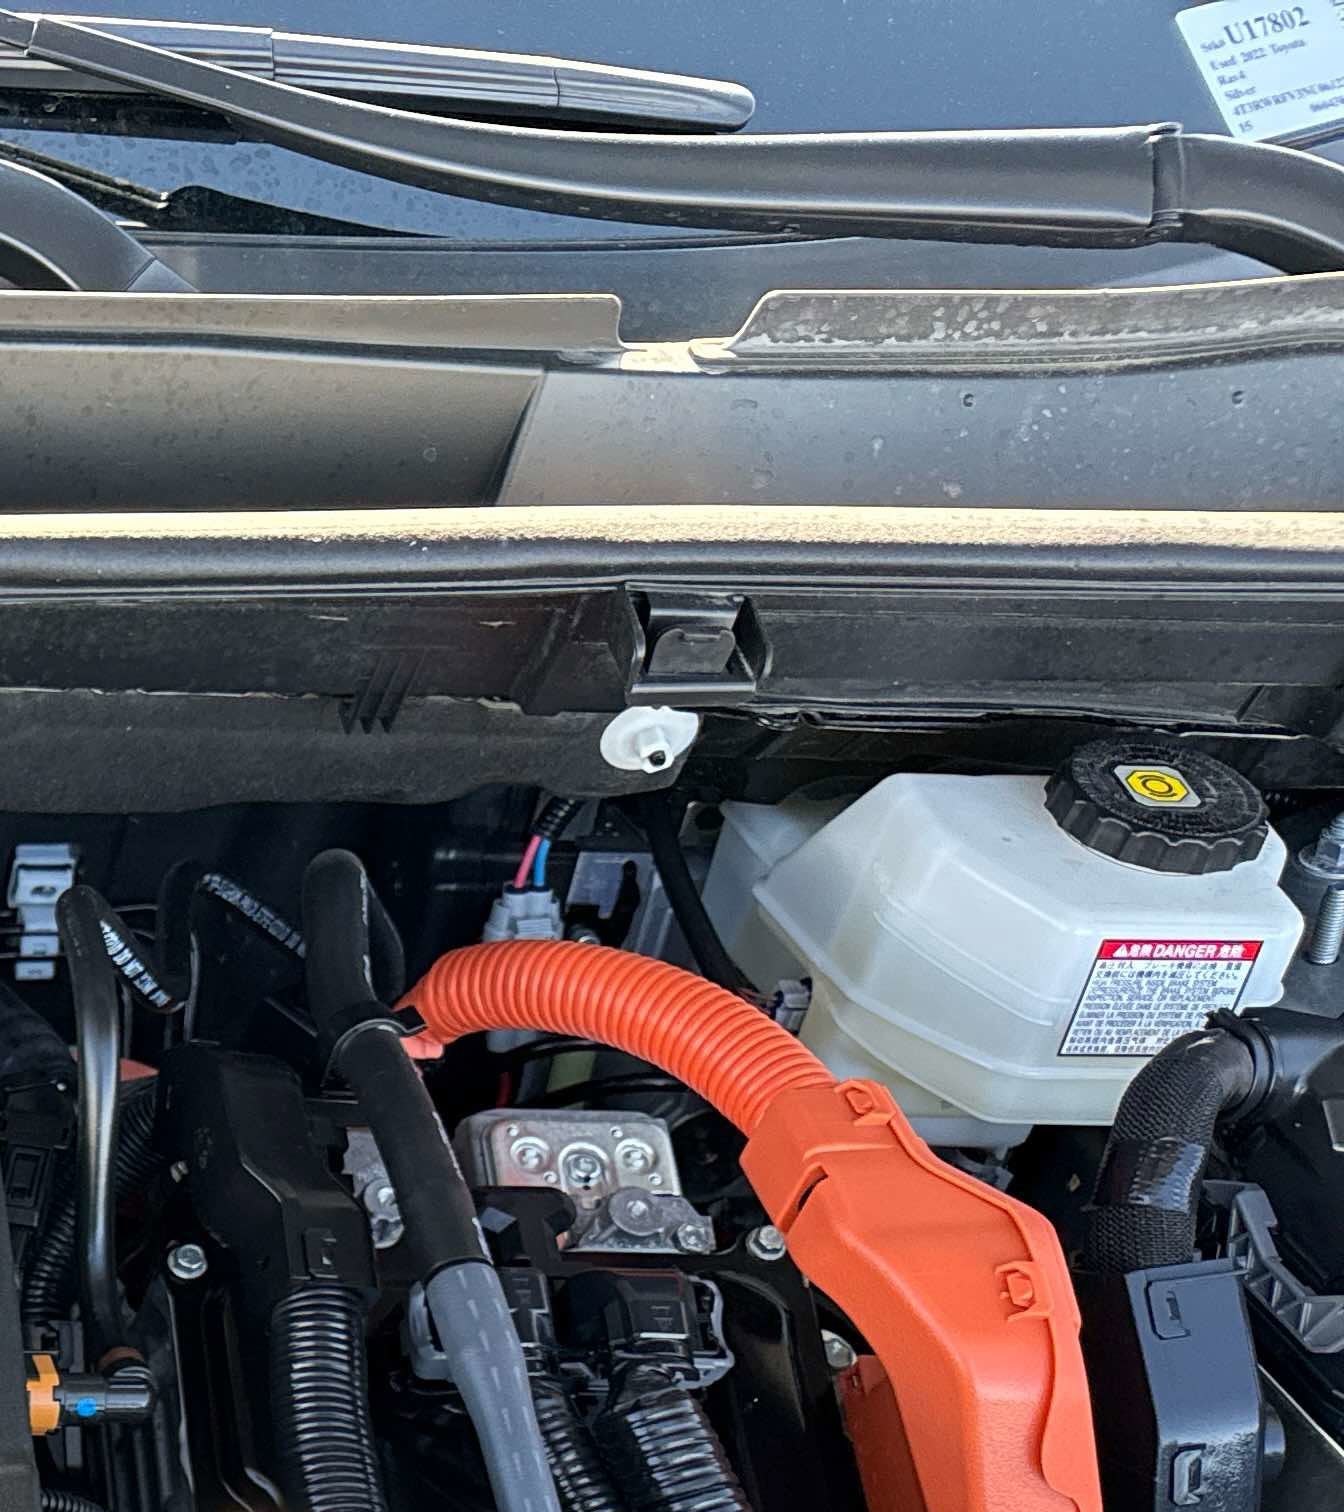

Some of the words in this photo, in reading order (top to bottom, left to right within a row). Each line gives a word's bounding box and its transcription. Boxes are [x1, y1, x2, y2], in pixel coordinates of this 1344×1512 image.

[1223, 6, 1310, 45] U17802
[1270, 38, 1307, 56] Toyota
[1224, 86, 1257, 101] Silver
[1153, 944, 1216, 958] DANGER
